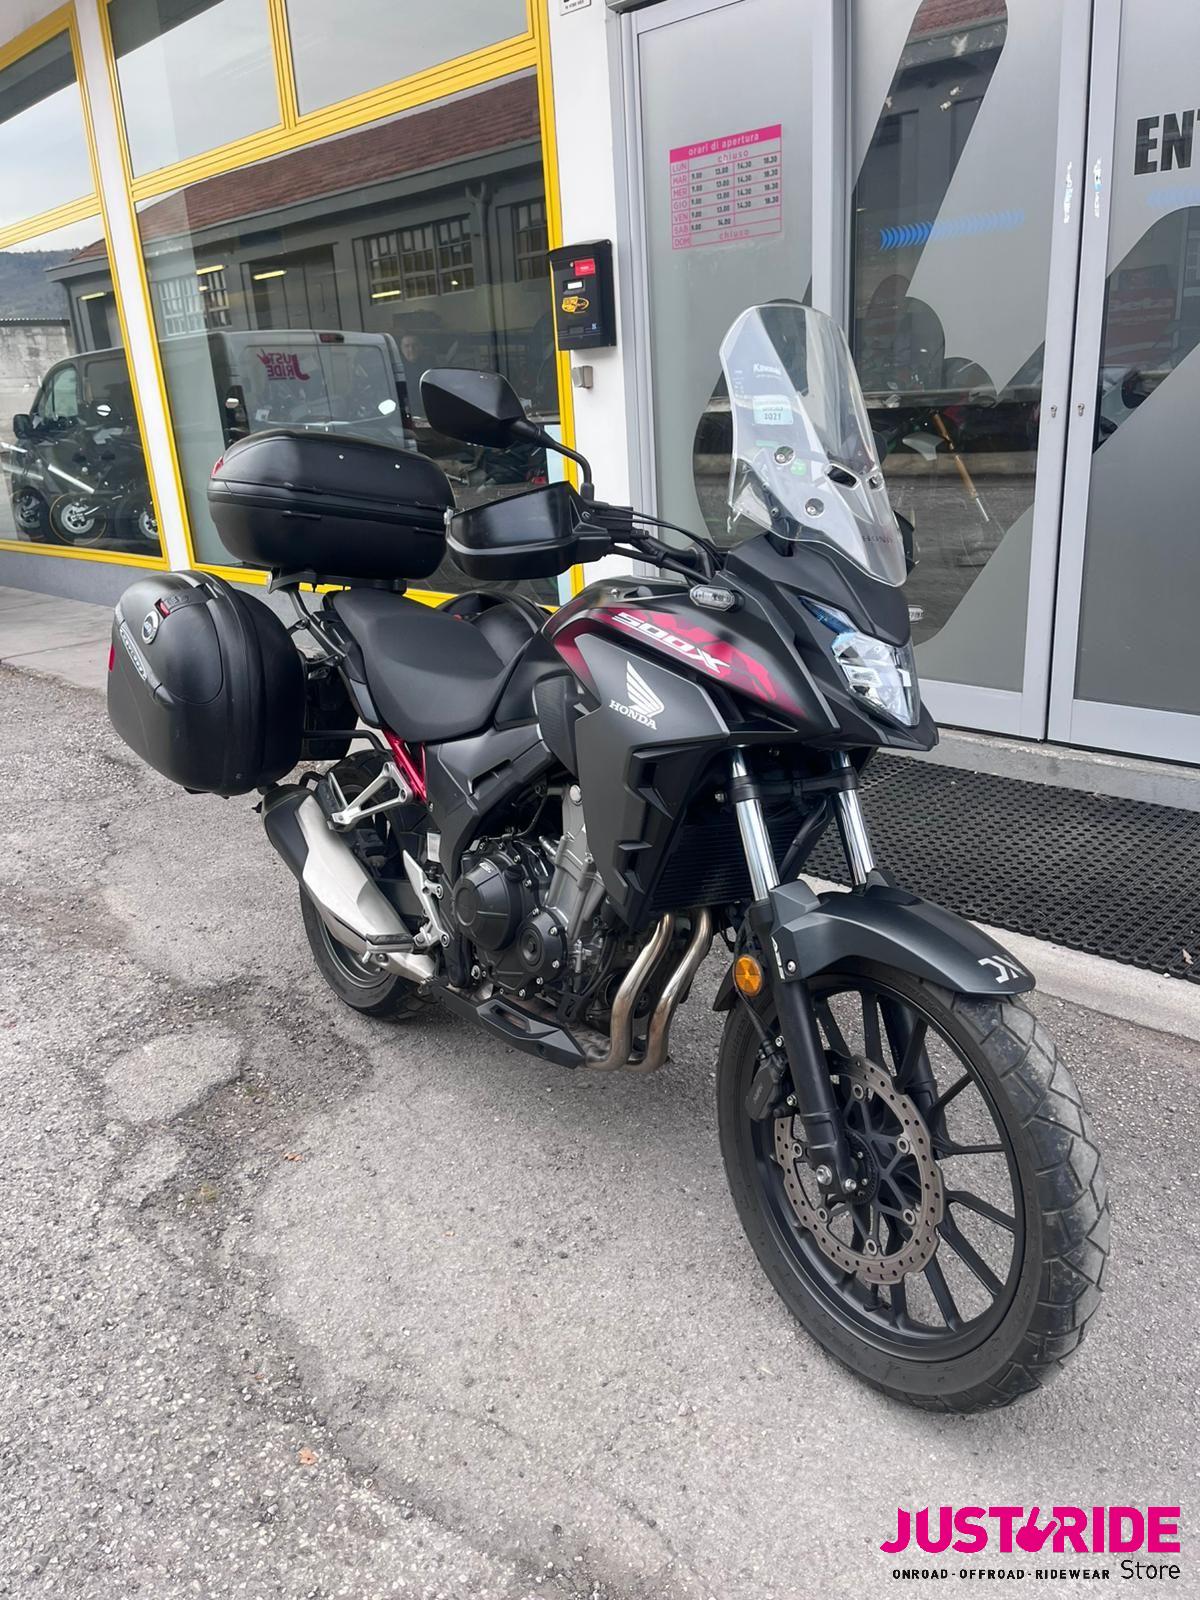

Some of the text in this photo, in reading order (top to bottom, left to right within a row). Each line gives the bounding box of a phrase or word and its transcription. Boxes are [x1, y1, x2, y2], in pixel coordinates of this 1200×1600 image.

[688, 133, 760, 156] orari di apertura
[1134, 108, 1200, 175] EN
[672, 150, 749, 173] LUN chiuso
[673, 200, 688, 210] GIO
[720, 229, 750, 240] chiuso
[612, 612, 730, 674] 500X
[609, 699, 657, 730] HONDA
